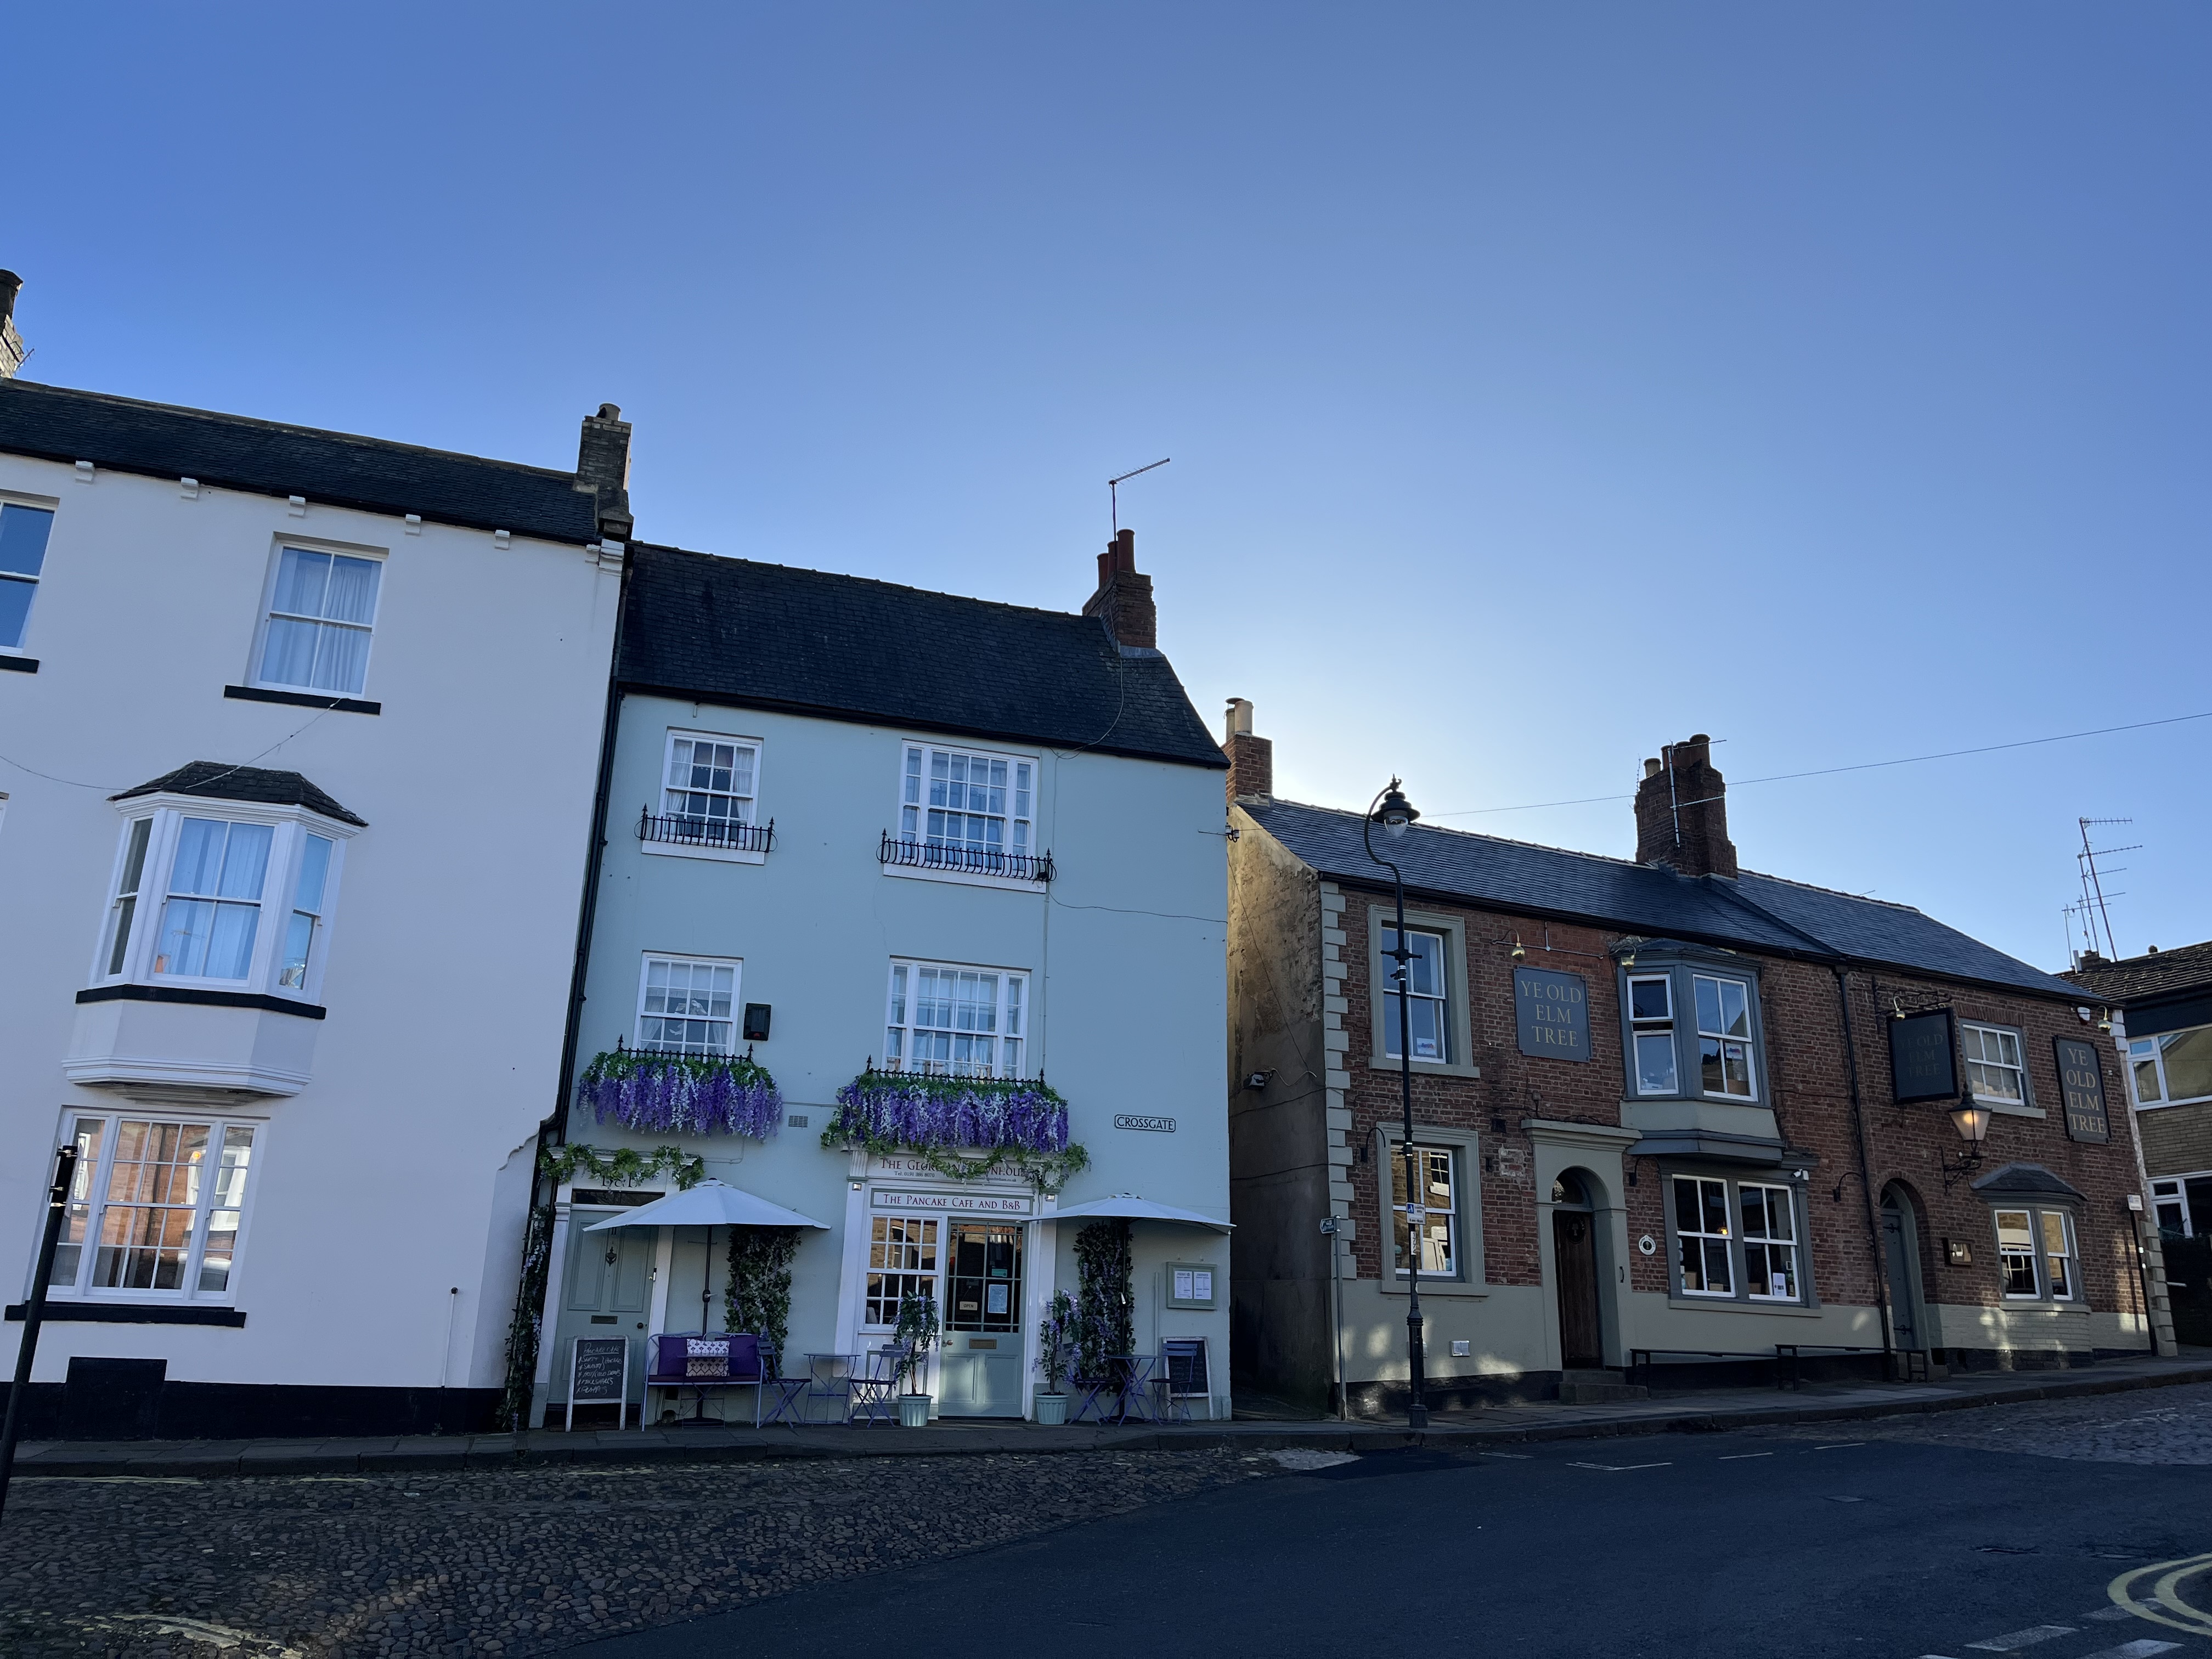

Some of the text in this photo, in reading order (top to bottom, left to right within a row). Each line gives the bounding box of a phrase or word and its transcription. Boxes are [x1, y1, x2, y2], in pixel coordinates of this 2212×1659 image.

[1521, 980, 1581, 1003] YE OLD
[1536, 1005, 1571, 1024] ELM
[1531, 1025, 1578, 1047] TREE
[1917, 1034, 1943, 1047] OLD
[1909, 1049, 1936, 1063] ELM
[2068, 1048, 2088, 1066] YE
[1908, 1063, 1940, 1077] TREE
[2066, 1070, 2096, 1088] OLD
[2070, 1091, 2100, 1111] ELM
[1117, 1116, 1174, 1130] CROSSGATE
[2069, 1114, 2107, 1134] TREE
[881, 1158, 902, 1170] THE
[883, 1194, 1020, 1210] THE PANCAKE CAFE AND B&B
